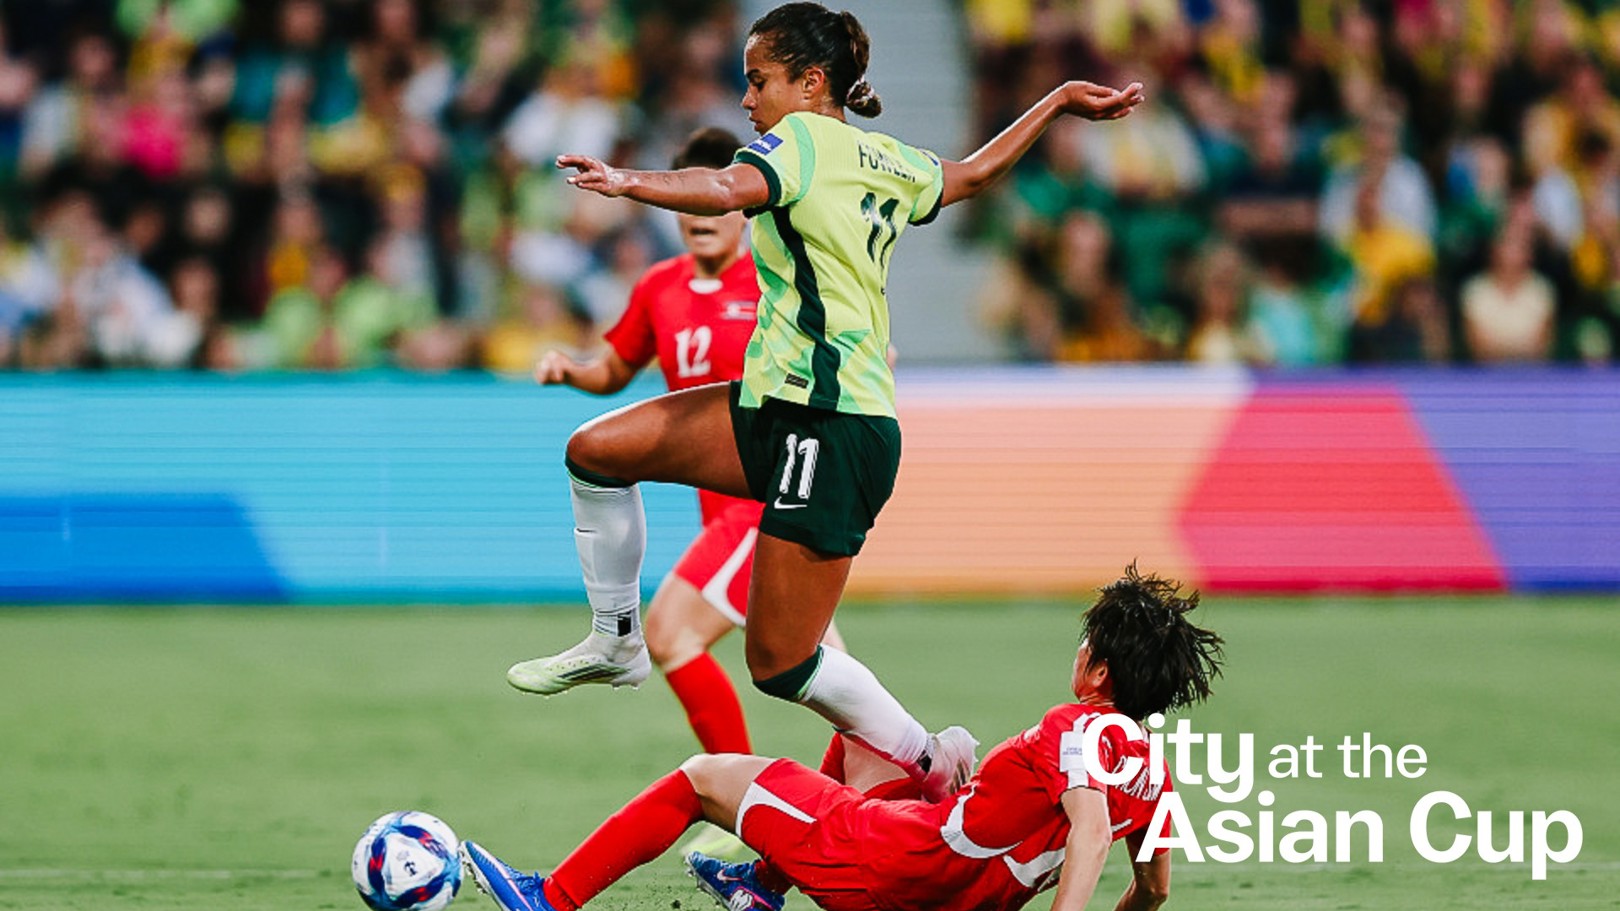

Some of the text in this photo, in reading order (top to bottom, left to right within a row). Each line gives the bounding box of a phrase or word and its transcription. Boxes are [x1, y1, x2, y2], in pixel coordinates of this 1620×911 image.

[860, 192, 900, 267] 11
[674, 325, 713, 378] 12
[779, 433, 819, 499] 11
